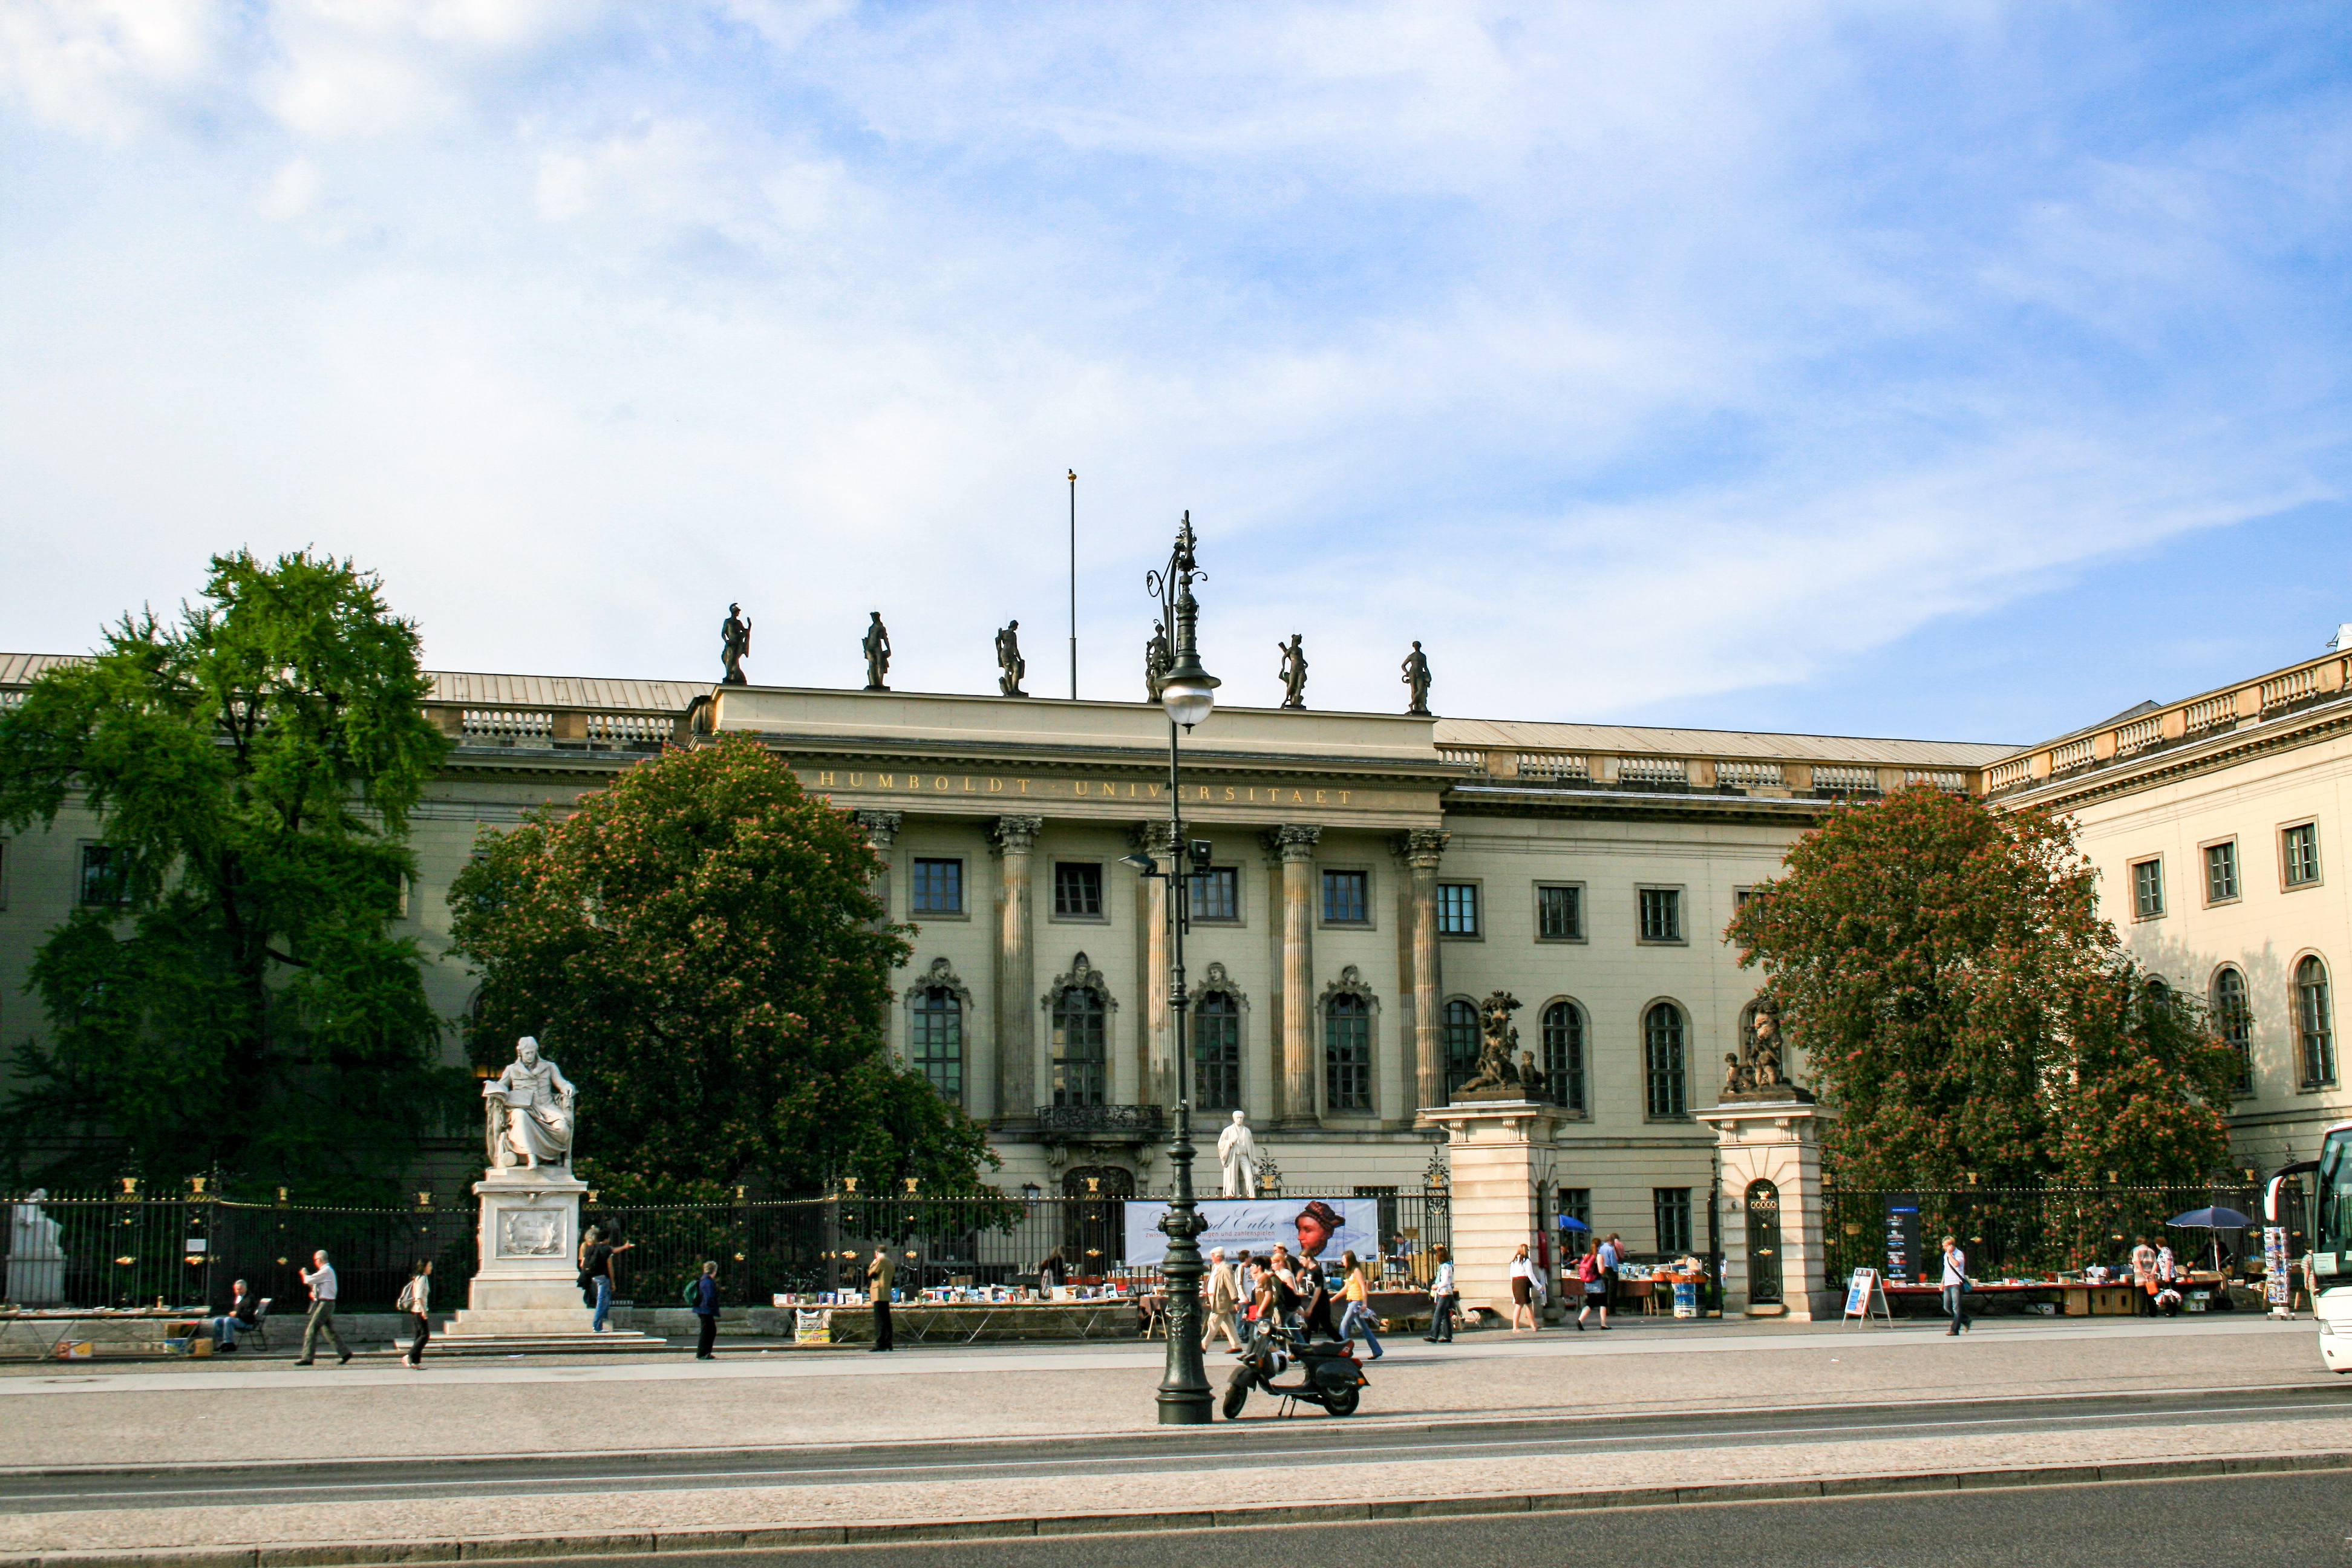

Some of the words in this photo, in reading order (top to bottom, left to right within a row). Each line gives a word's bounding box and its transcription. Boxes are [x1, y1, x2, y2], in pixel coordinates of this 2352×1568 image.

[820, 771, 1031, 793] HUMBOLDT
[1075, 782, 1351, 805] UNIVERSITAET
[1233, 1207, 1275, 1229] Euler
